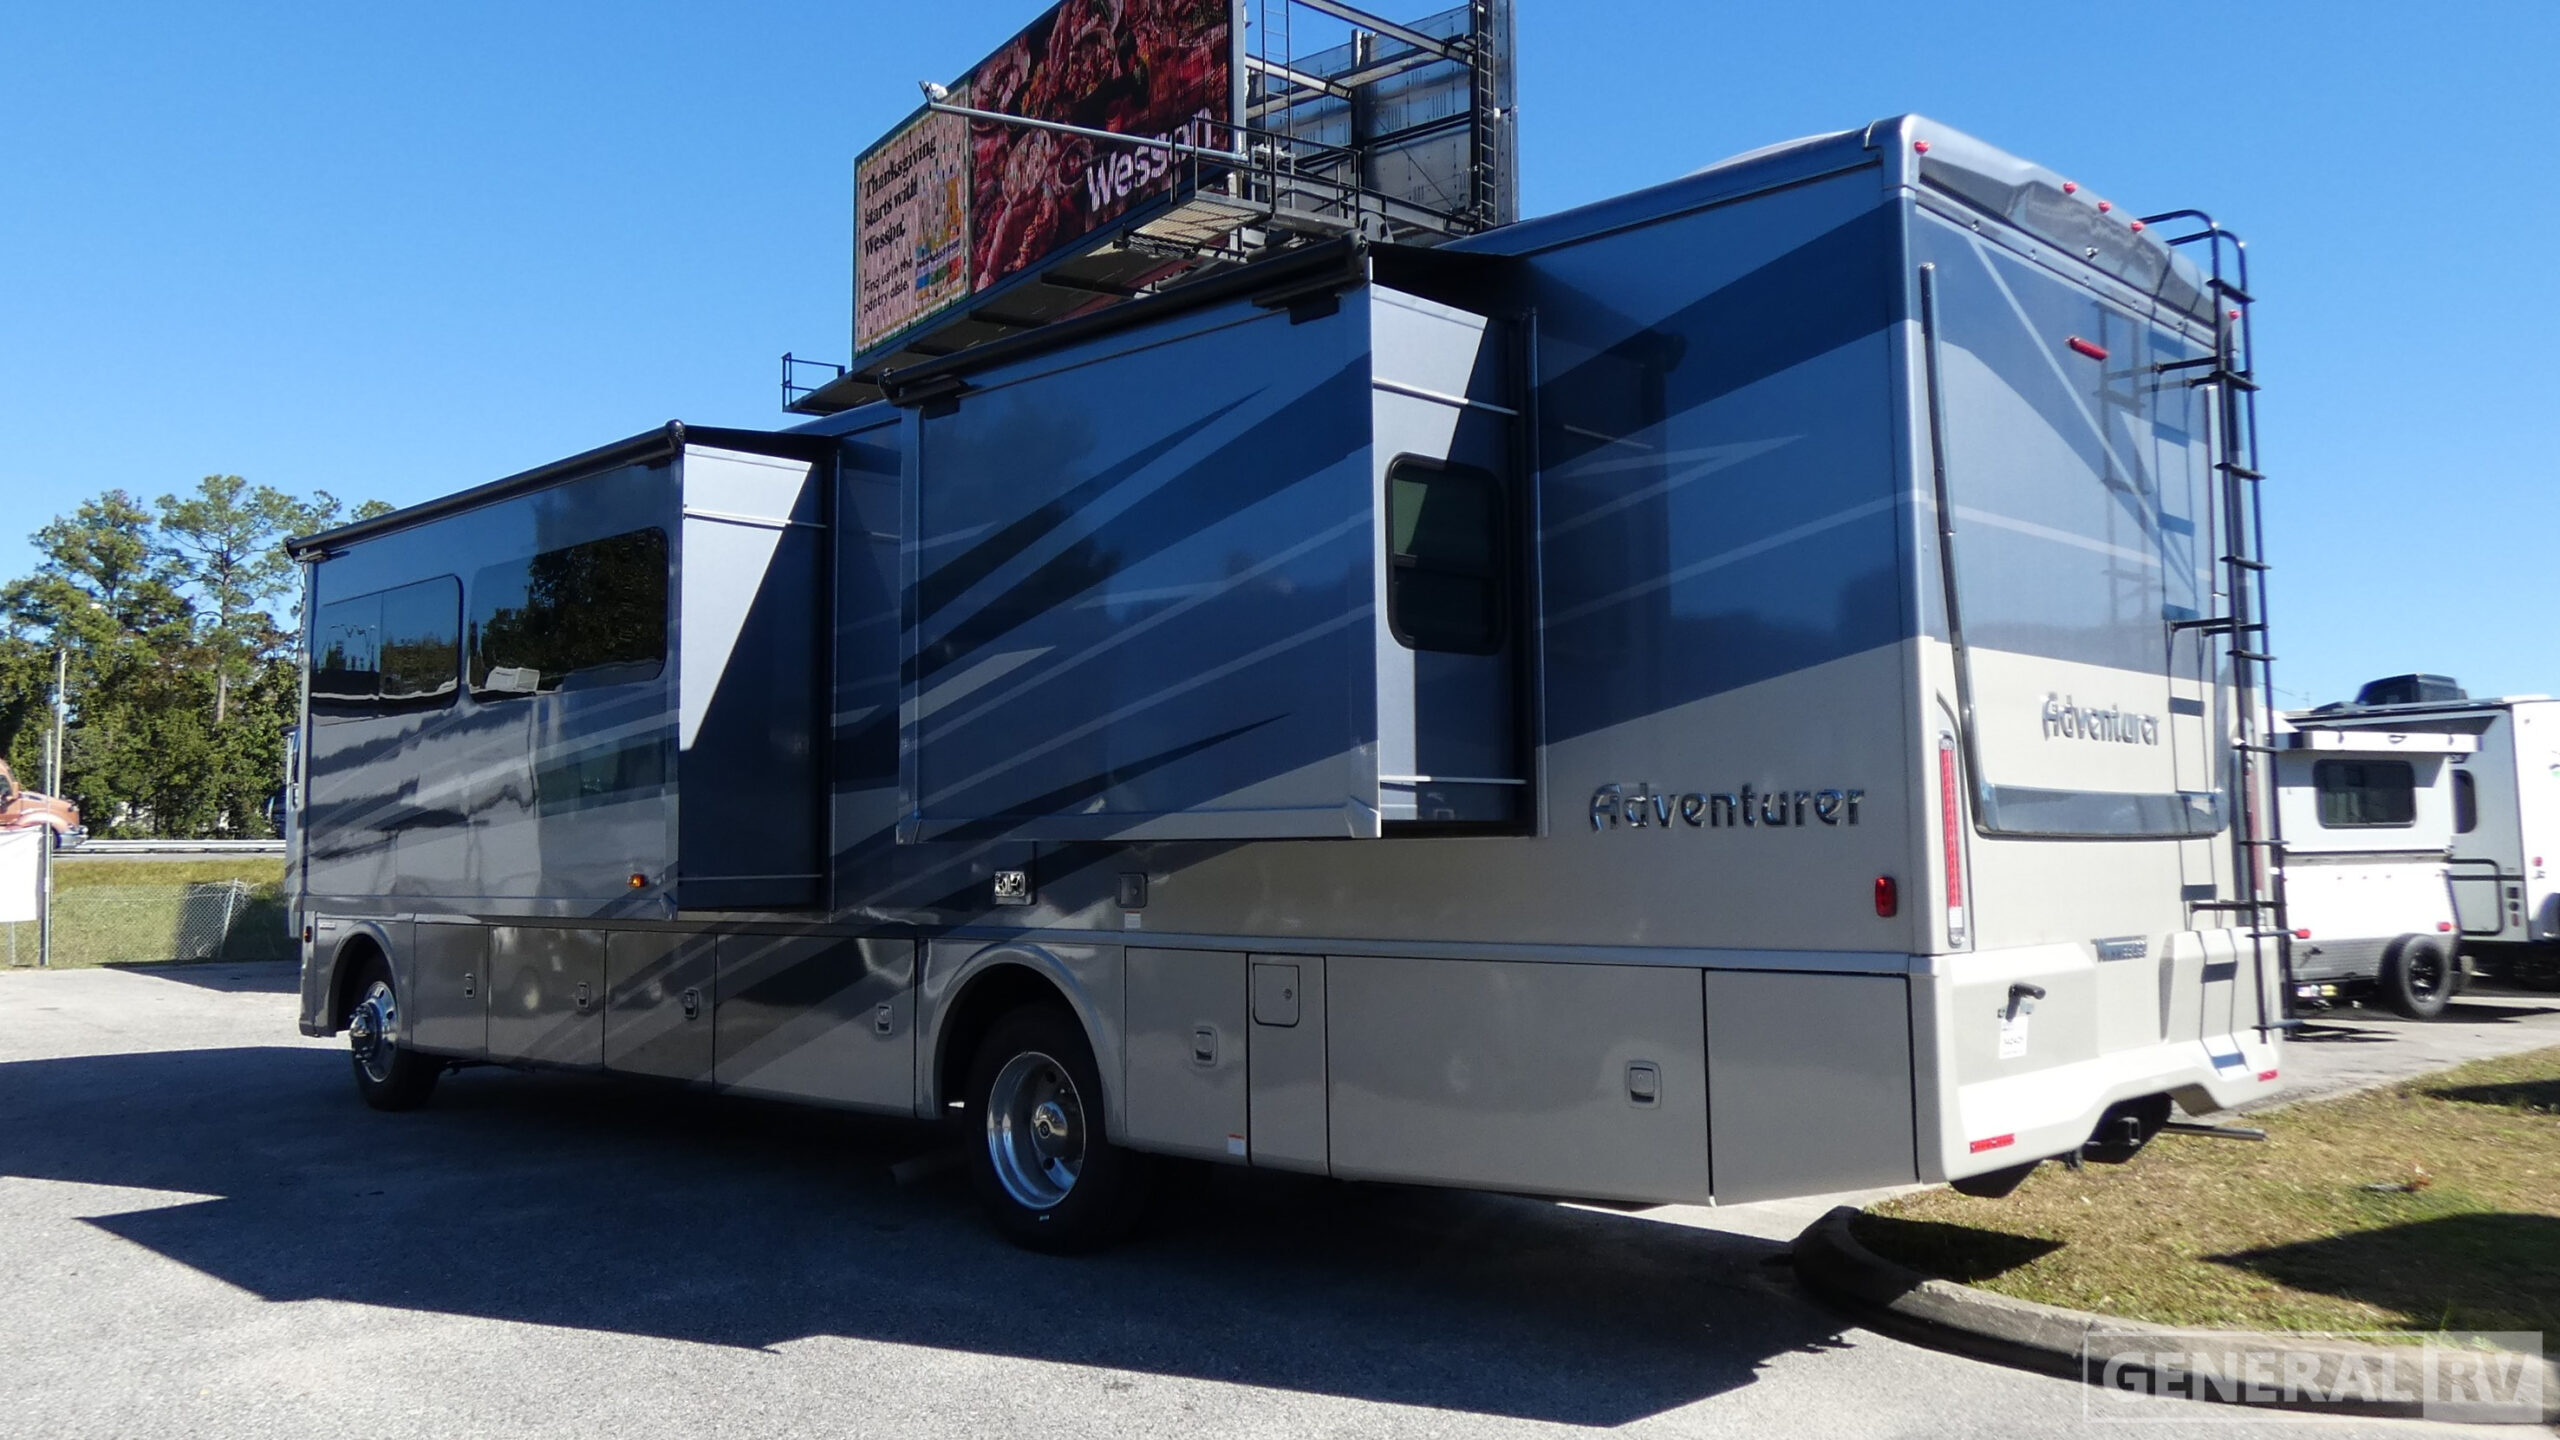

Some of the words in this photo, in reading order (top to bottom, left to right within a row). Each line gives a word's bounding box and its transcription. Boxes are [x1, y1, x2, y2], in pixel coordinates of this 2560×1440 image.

[865, 135, 937, 199] Thanksgiving
[1086, 107, 1212, 212] Wesson
[865, 197, 893, 229] starts
[894, 175, 918, 206] with
[900, 256, 913, 274] the
[2042, 692, 2159, 746] Adventurer
[1589, 782, 1865, 832] Adventurer
